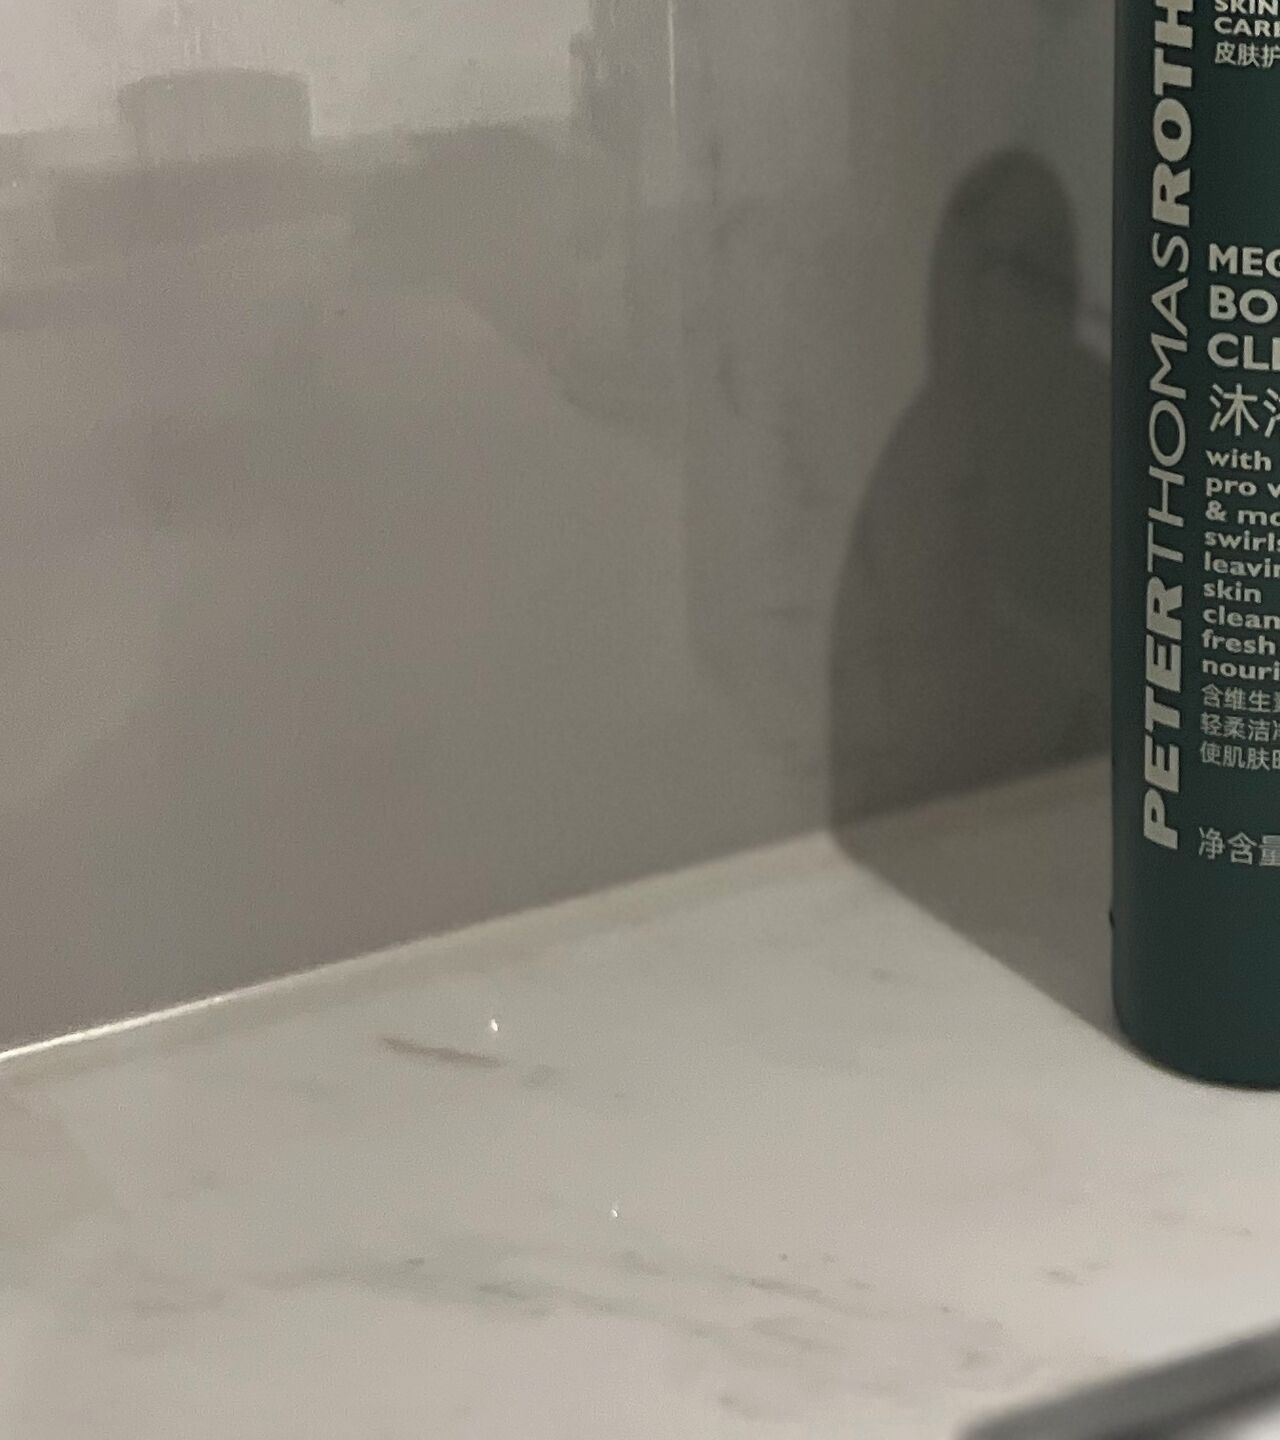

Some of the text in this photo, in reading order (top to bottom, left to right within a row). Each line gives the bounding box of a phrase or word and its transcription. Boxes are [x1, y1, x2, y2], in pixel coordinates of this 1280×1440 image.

[1206, 449, 1272, 472] with
[1206, 477, 1257, 498] pro
[1205, 501, 1227, 522] &
[1203, 581, 1262, 604] skin
[1202, 630, 1276, 657] fresh
